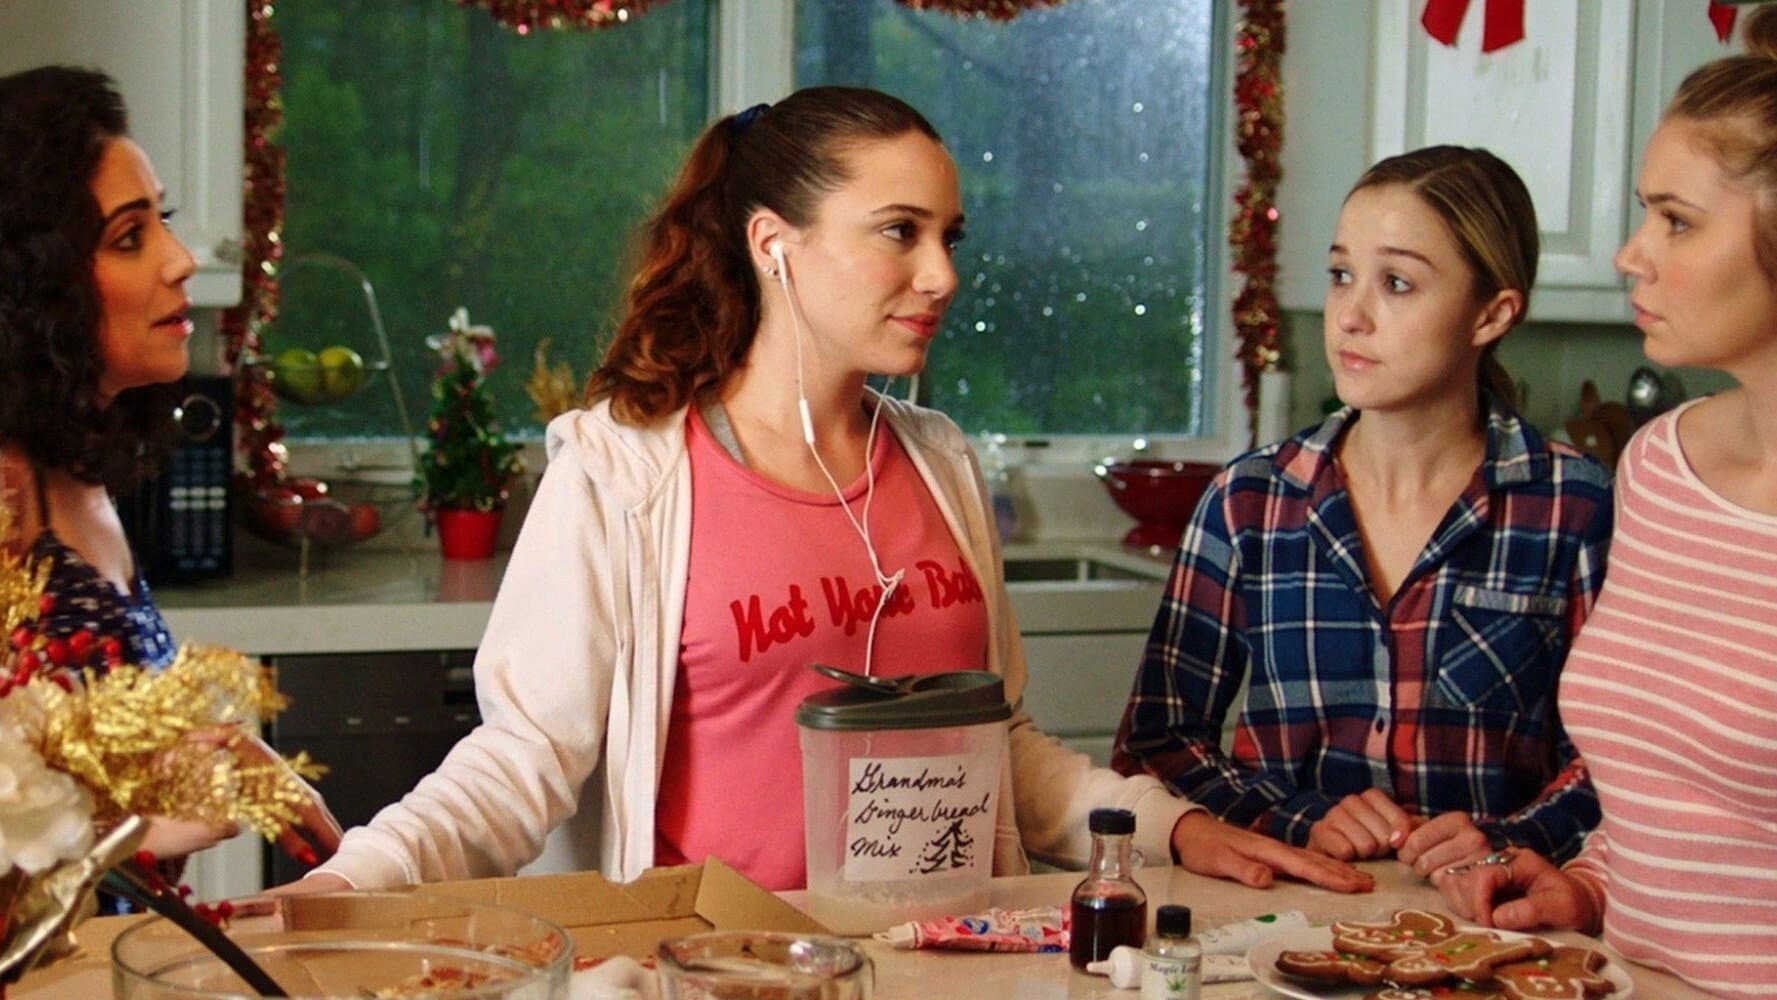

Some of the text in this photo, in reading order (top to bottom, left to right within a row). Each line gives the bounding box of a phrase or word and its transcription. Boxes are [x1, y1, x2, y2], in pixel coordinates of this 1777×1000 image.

[730, 584, 815, 662] Not
[820, 576, 915, 637] Your
[852, 763, 966, 794] Grandma's
[851, 835, 902, 858] Mix
